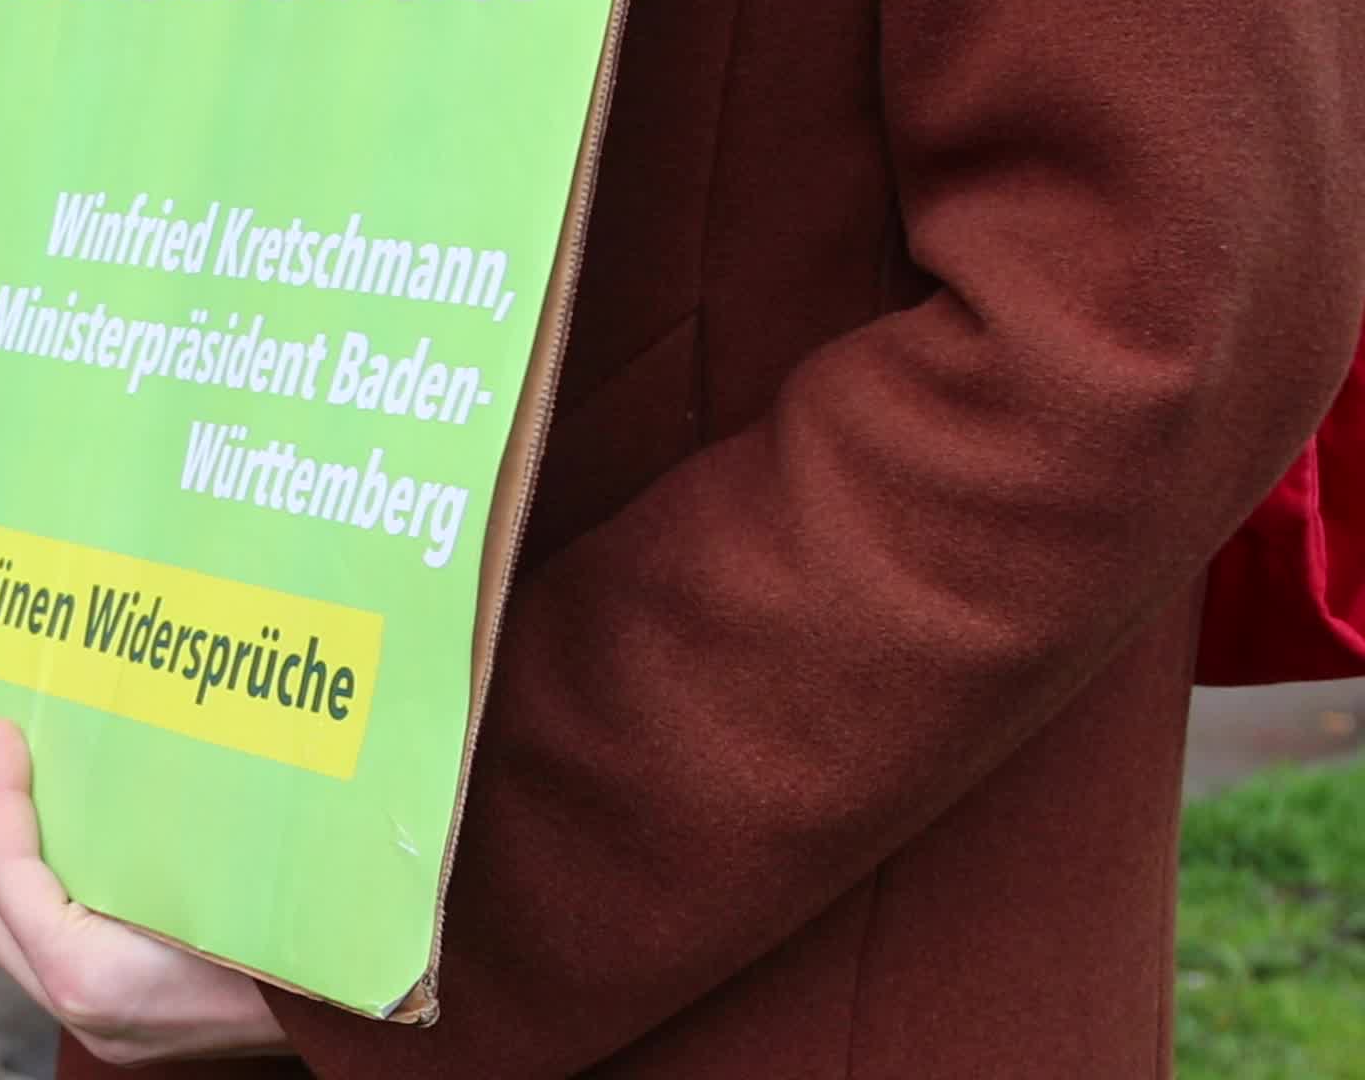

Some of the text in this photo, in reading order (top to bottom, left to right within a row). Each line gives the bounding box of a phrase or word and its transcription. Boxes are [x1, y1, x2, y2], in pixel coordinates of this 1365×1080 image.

[46, 190, 515, 322] Winfried Kretschmann,
[326, 330, 494, 425] Baden-
[179, 420, 470, 570] Württemberg
[82, 583, 357, 722] Widersprüche
